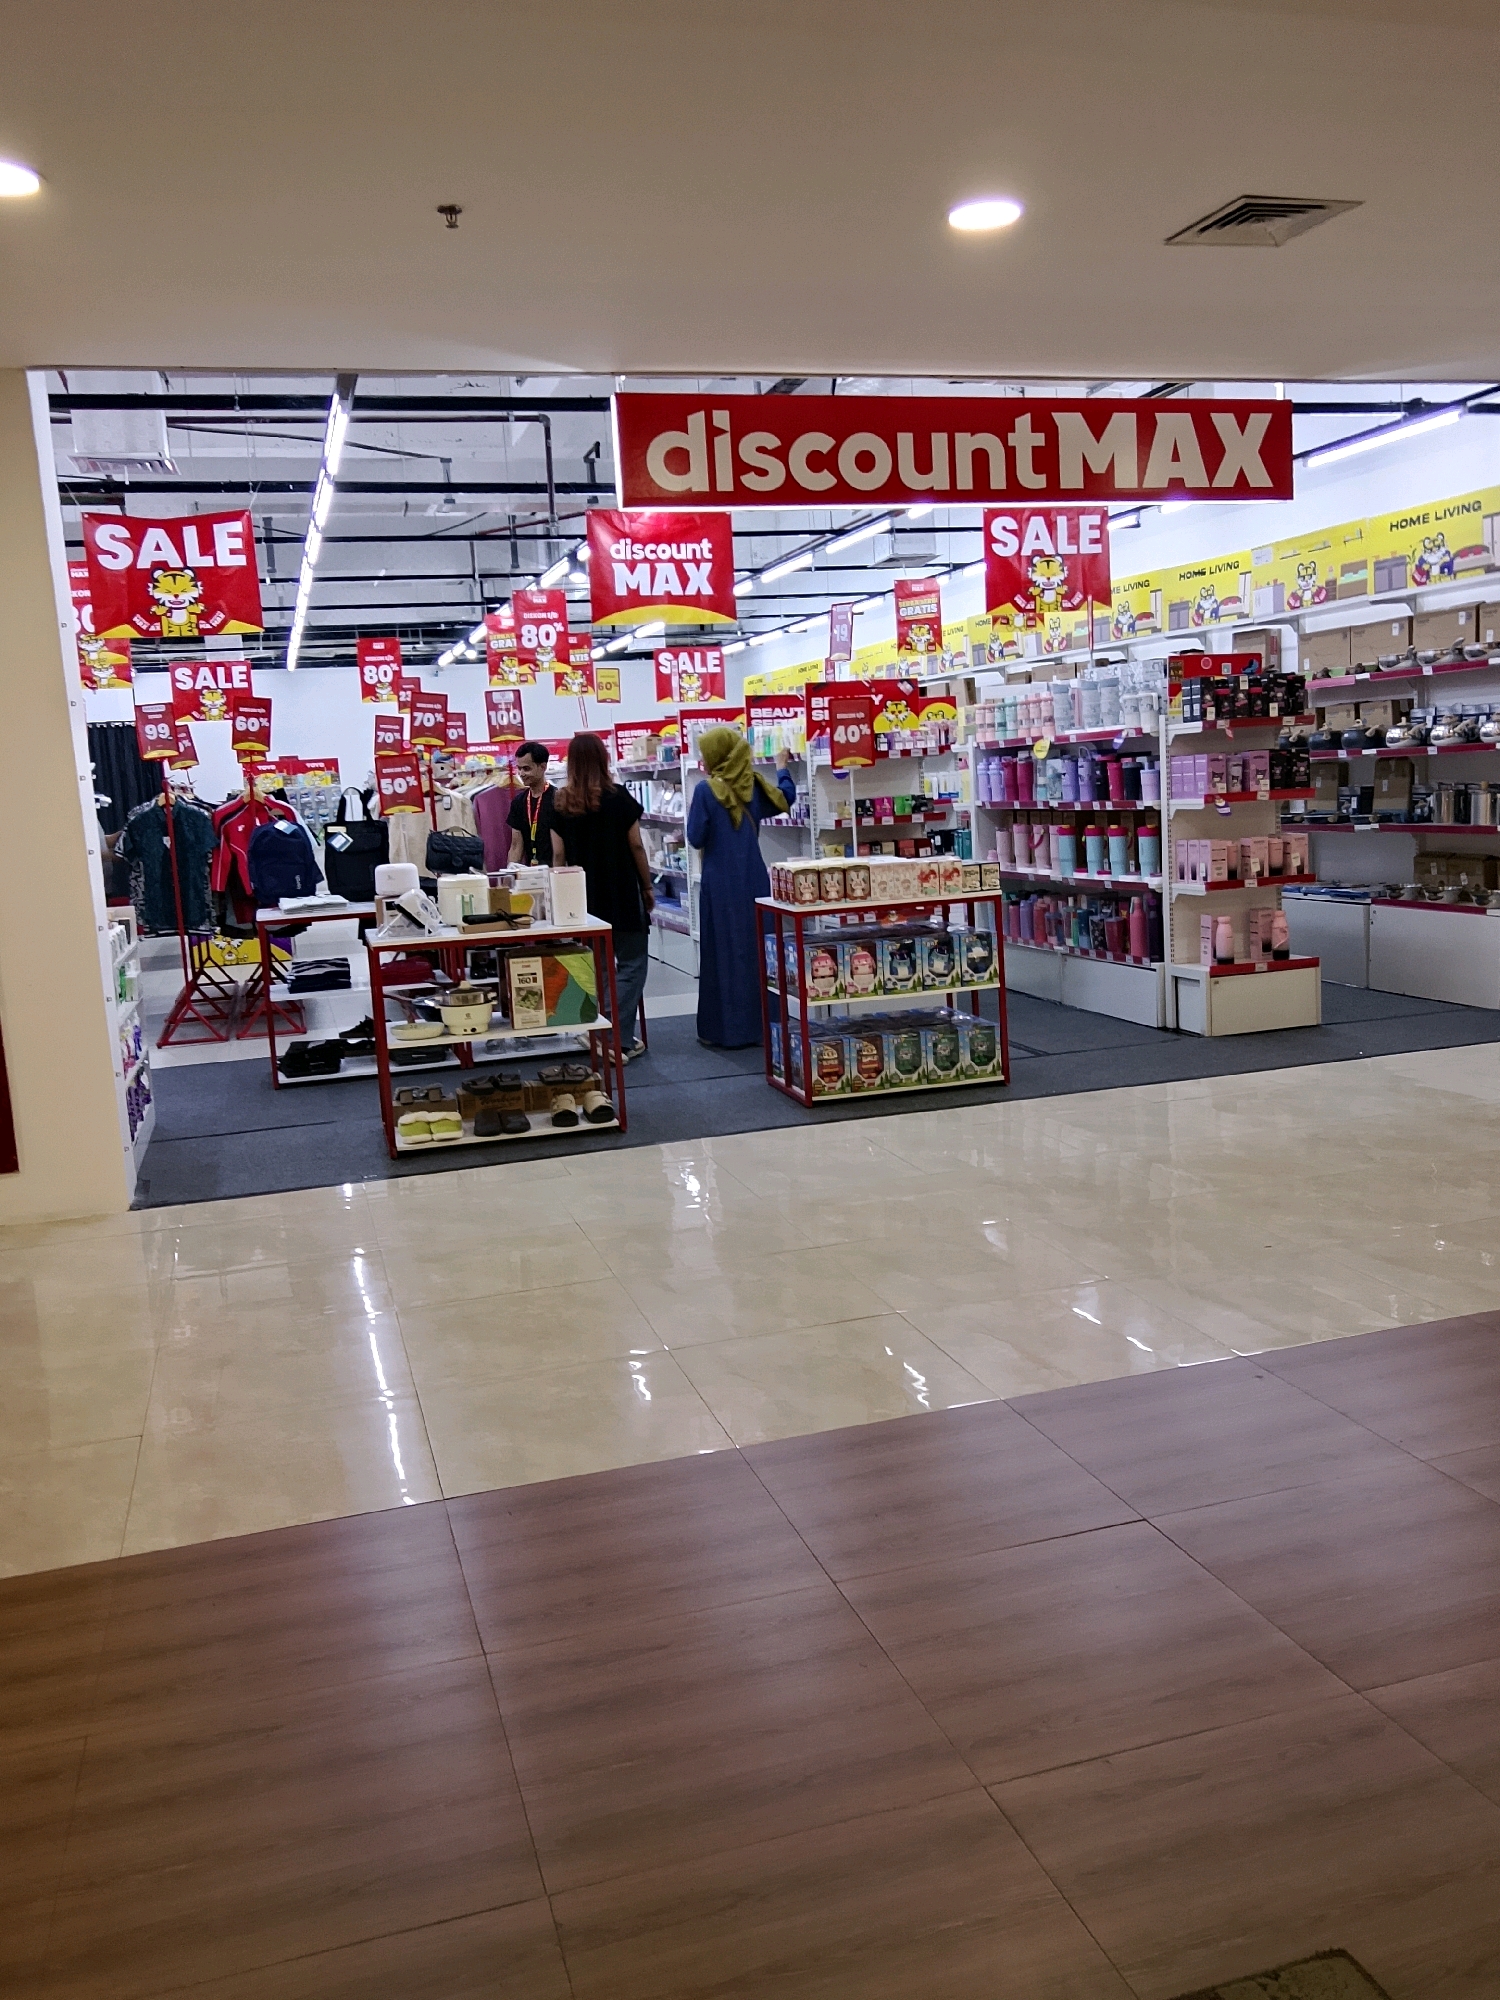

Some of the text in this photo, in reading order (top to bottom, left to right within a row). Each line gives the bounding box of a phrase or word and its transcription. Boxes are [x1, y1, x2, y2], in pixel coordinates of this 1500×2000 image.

[1390, 500, 1483, 532] HOME LIVING
[94, 520, 247, 571] SALE
[990, 514, 1103, 557] SALE
[609, 537, 713, 560] discount
[611, 562, 714, 596] MAX
[1179, 560, 1240, 581] HOME LIVING
[1123, 579, 1151, 593] LIVING
[899, 603, 938, 617] GRATIS
[521, 621, 565, 649] 80%
[947, 625, 964, 636] LIVING
[658, 651, 722, 674] SALE
[174, 665, 249, 691] SALE
[363, 663, 400, 685] 80%
[235, 716, 270, 732] 60%
[412, 711, 445, 727] 70%
[376, 731, 402, 744] 70%
[833, 723, 872, 744] 40%
[379, 775, 418, 796] 50%
[517, 976, 532, 985] 160
